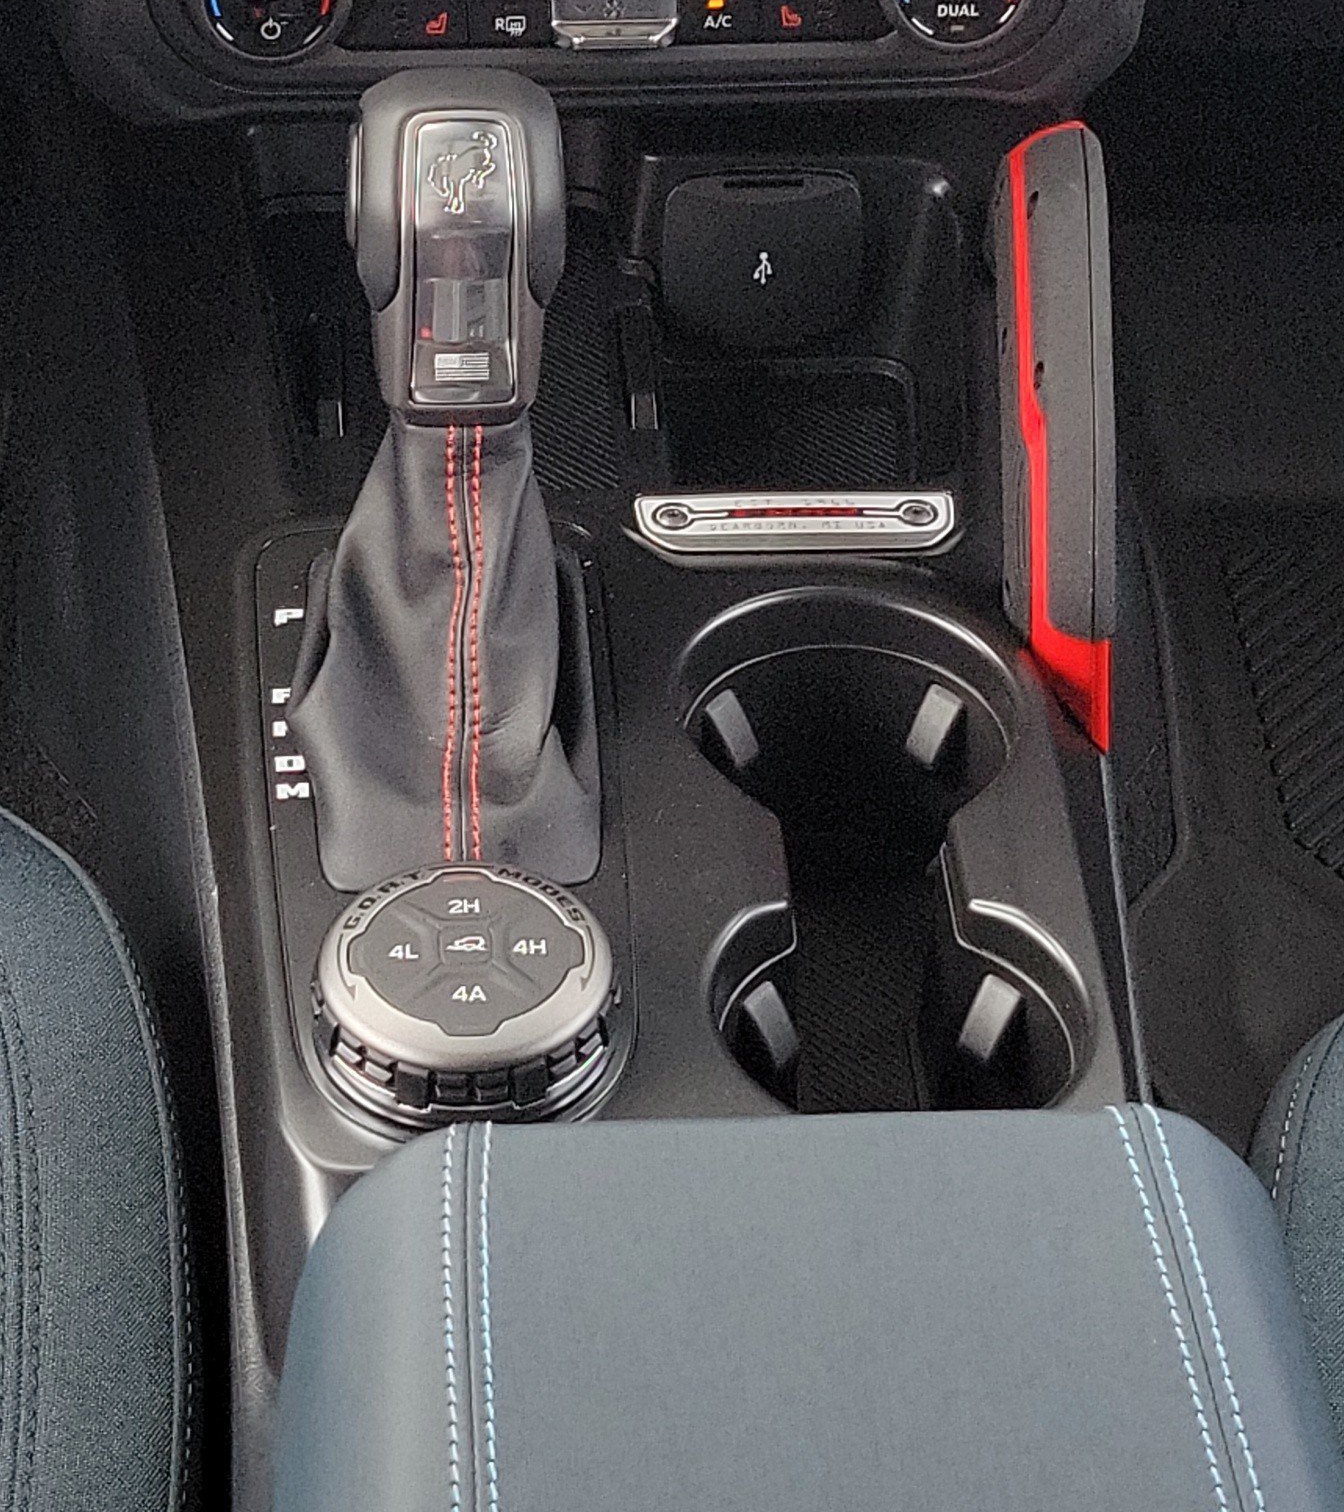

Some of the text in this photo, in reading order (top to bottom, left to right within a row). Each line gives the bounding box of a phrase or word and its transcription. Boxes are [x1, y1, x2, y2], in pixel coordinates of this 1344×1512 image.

[937, 3, 980, 18] DUAL
[494, 18, 504, 31] R
[703, 14, 733, 29] A/C
[275, 781, 310, 800] M
[497, 867, 585, 923] MODES
[448, 898, 480, 914] 2H
[388, 944, 419, 960] 4L
[512, 939, 547, 956] 4H
[452, 985, 488, 1002] 4A
